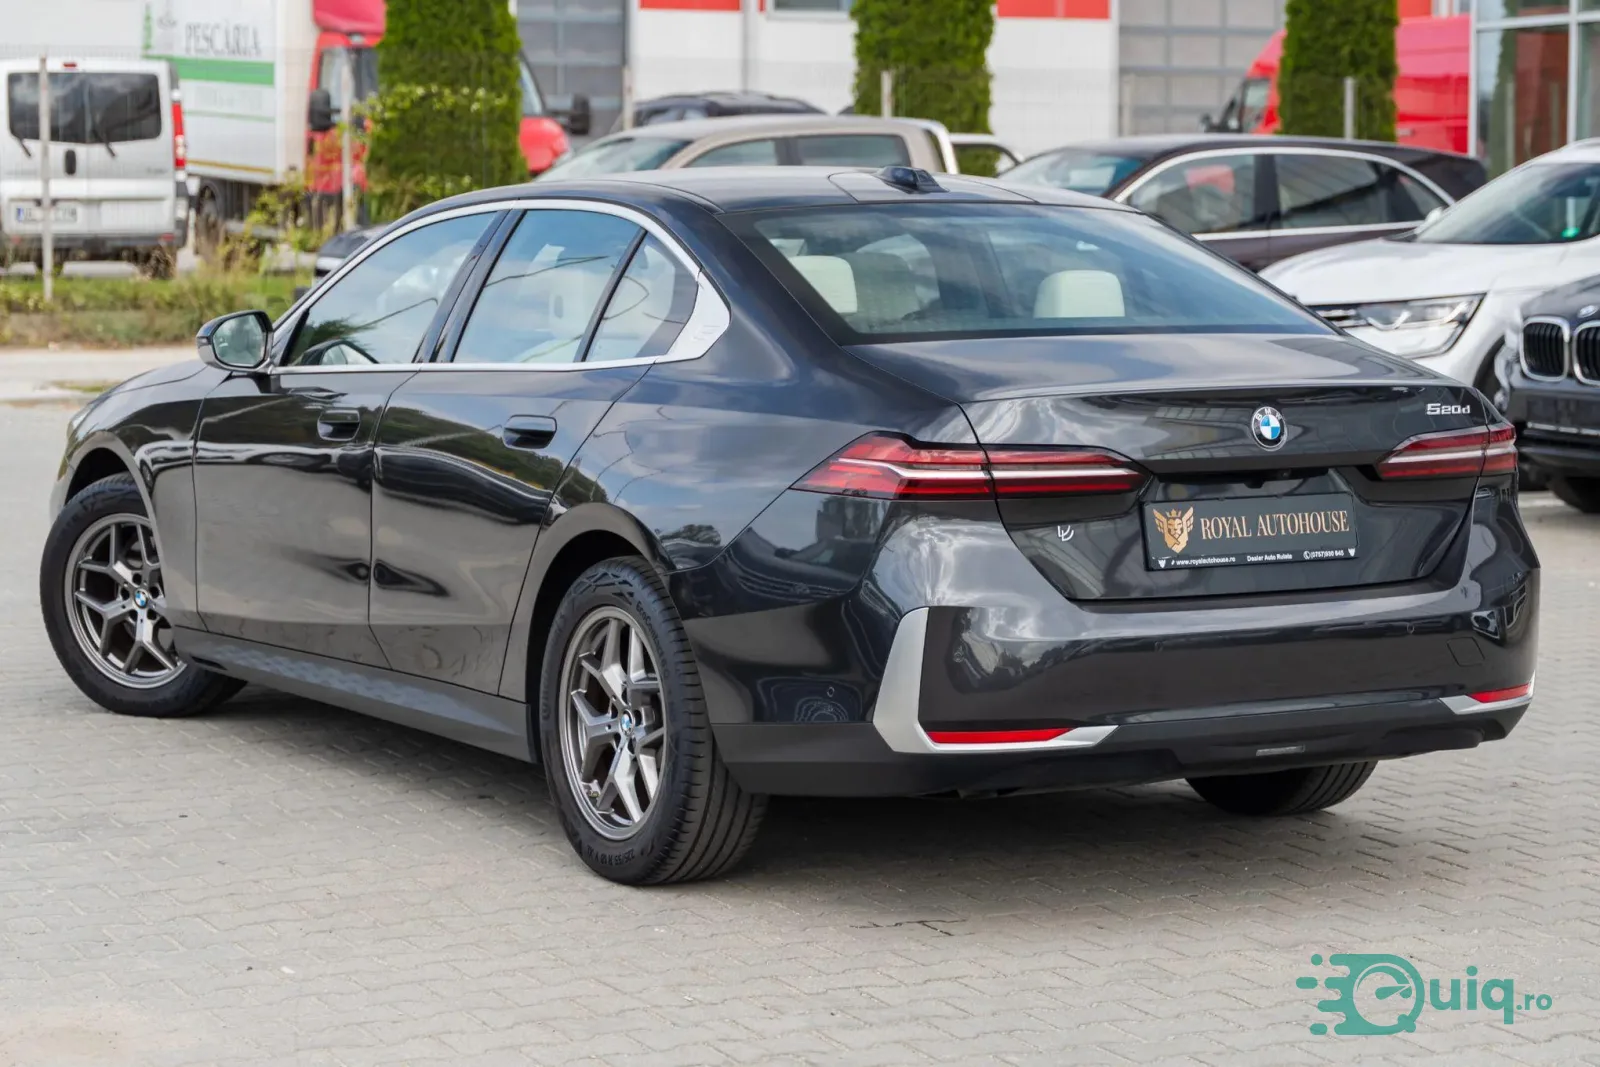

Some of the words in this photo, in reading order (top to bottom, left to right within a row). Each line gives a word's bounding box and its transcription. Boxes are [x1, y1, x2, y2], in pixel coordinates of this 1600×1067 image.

[1426, 402, 1471, 415] 520d
[1200, 515, 1253, 540] ROYAL
[1256, 510, 1350, 537] AUTOHOUSE
